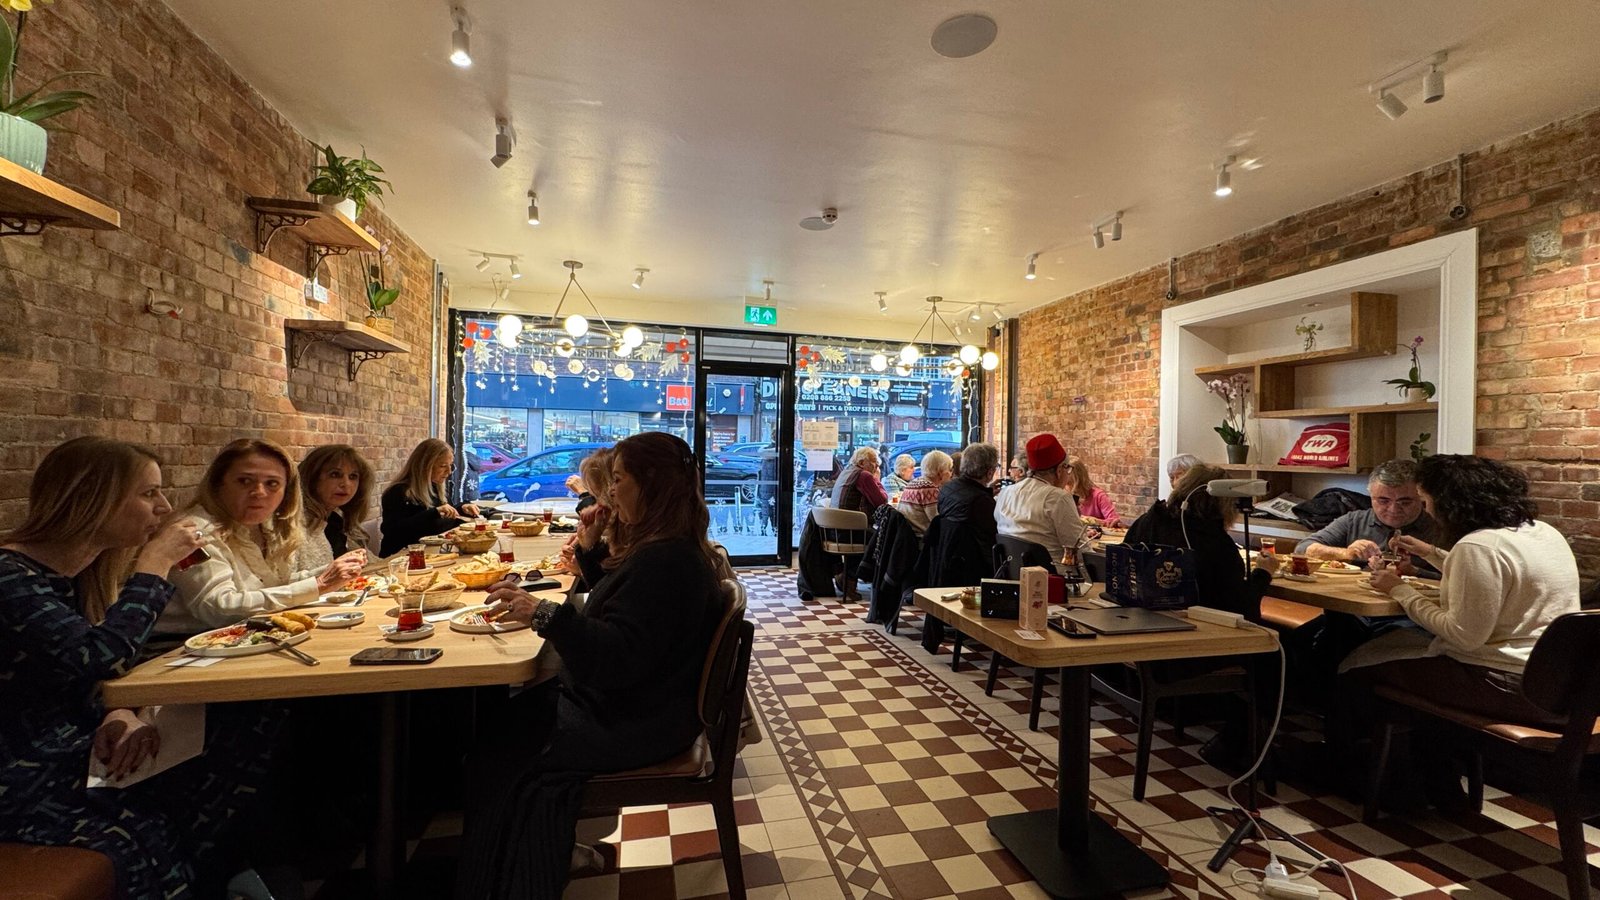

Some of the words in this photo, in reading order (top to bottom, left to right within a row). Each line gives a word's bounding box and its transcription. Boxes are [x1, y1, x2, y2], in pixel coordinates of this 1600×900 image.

[802, 384, 889, 402] CLEANERS
[668, 396, 689, 406] B&Q
[1305, 440, 1334, 448] TWA
